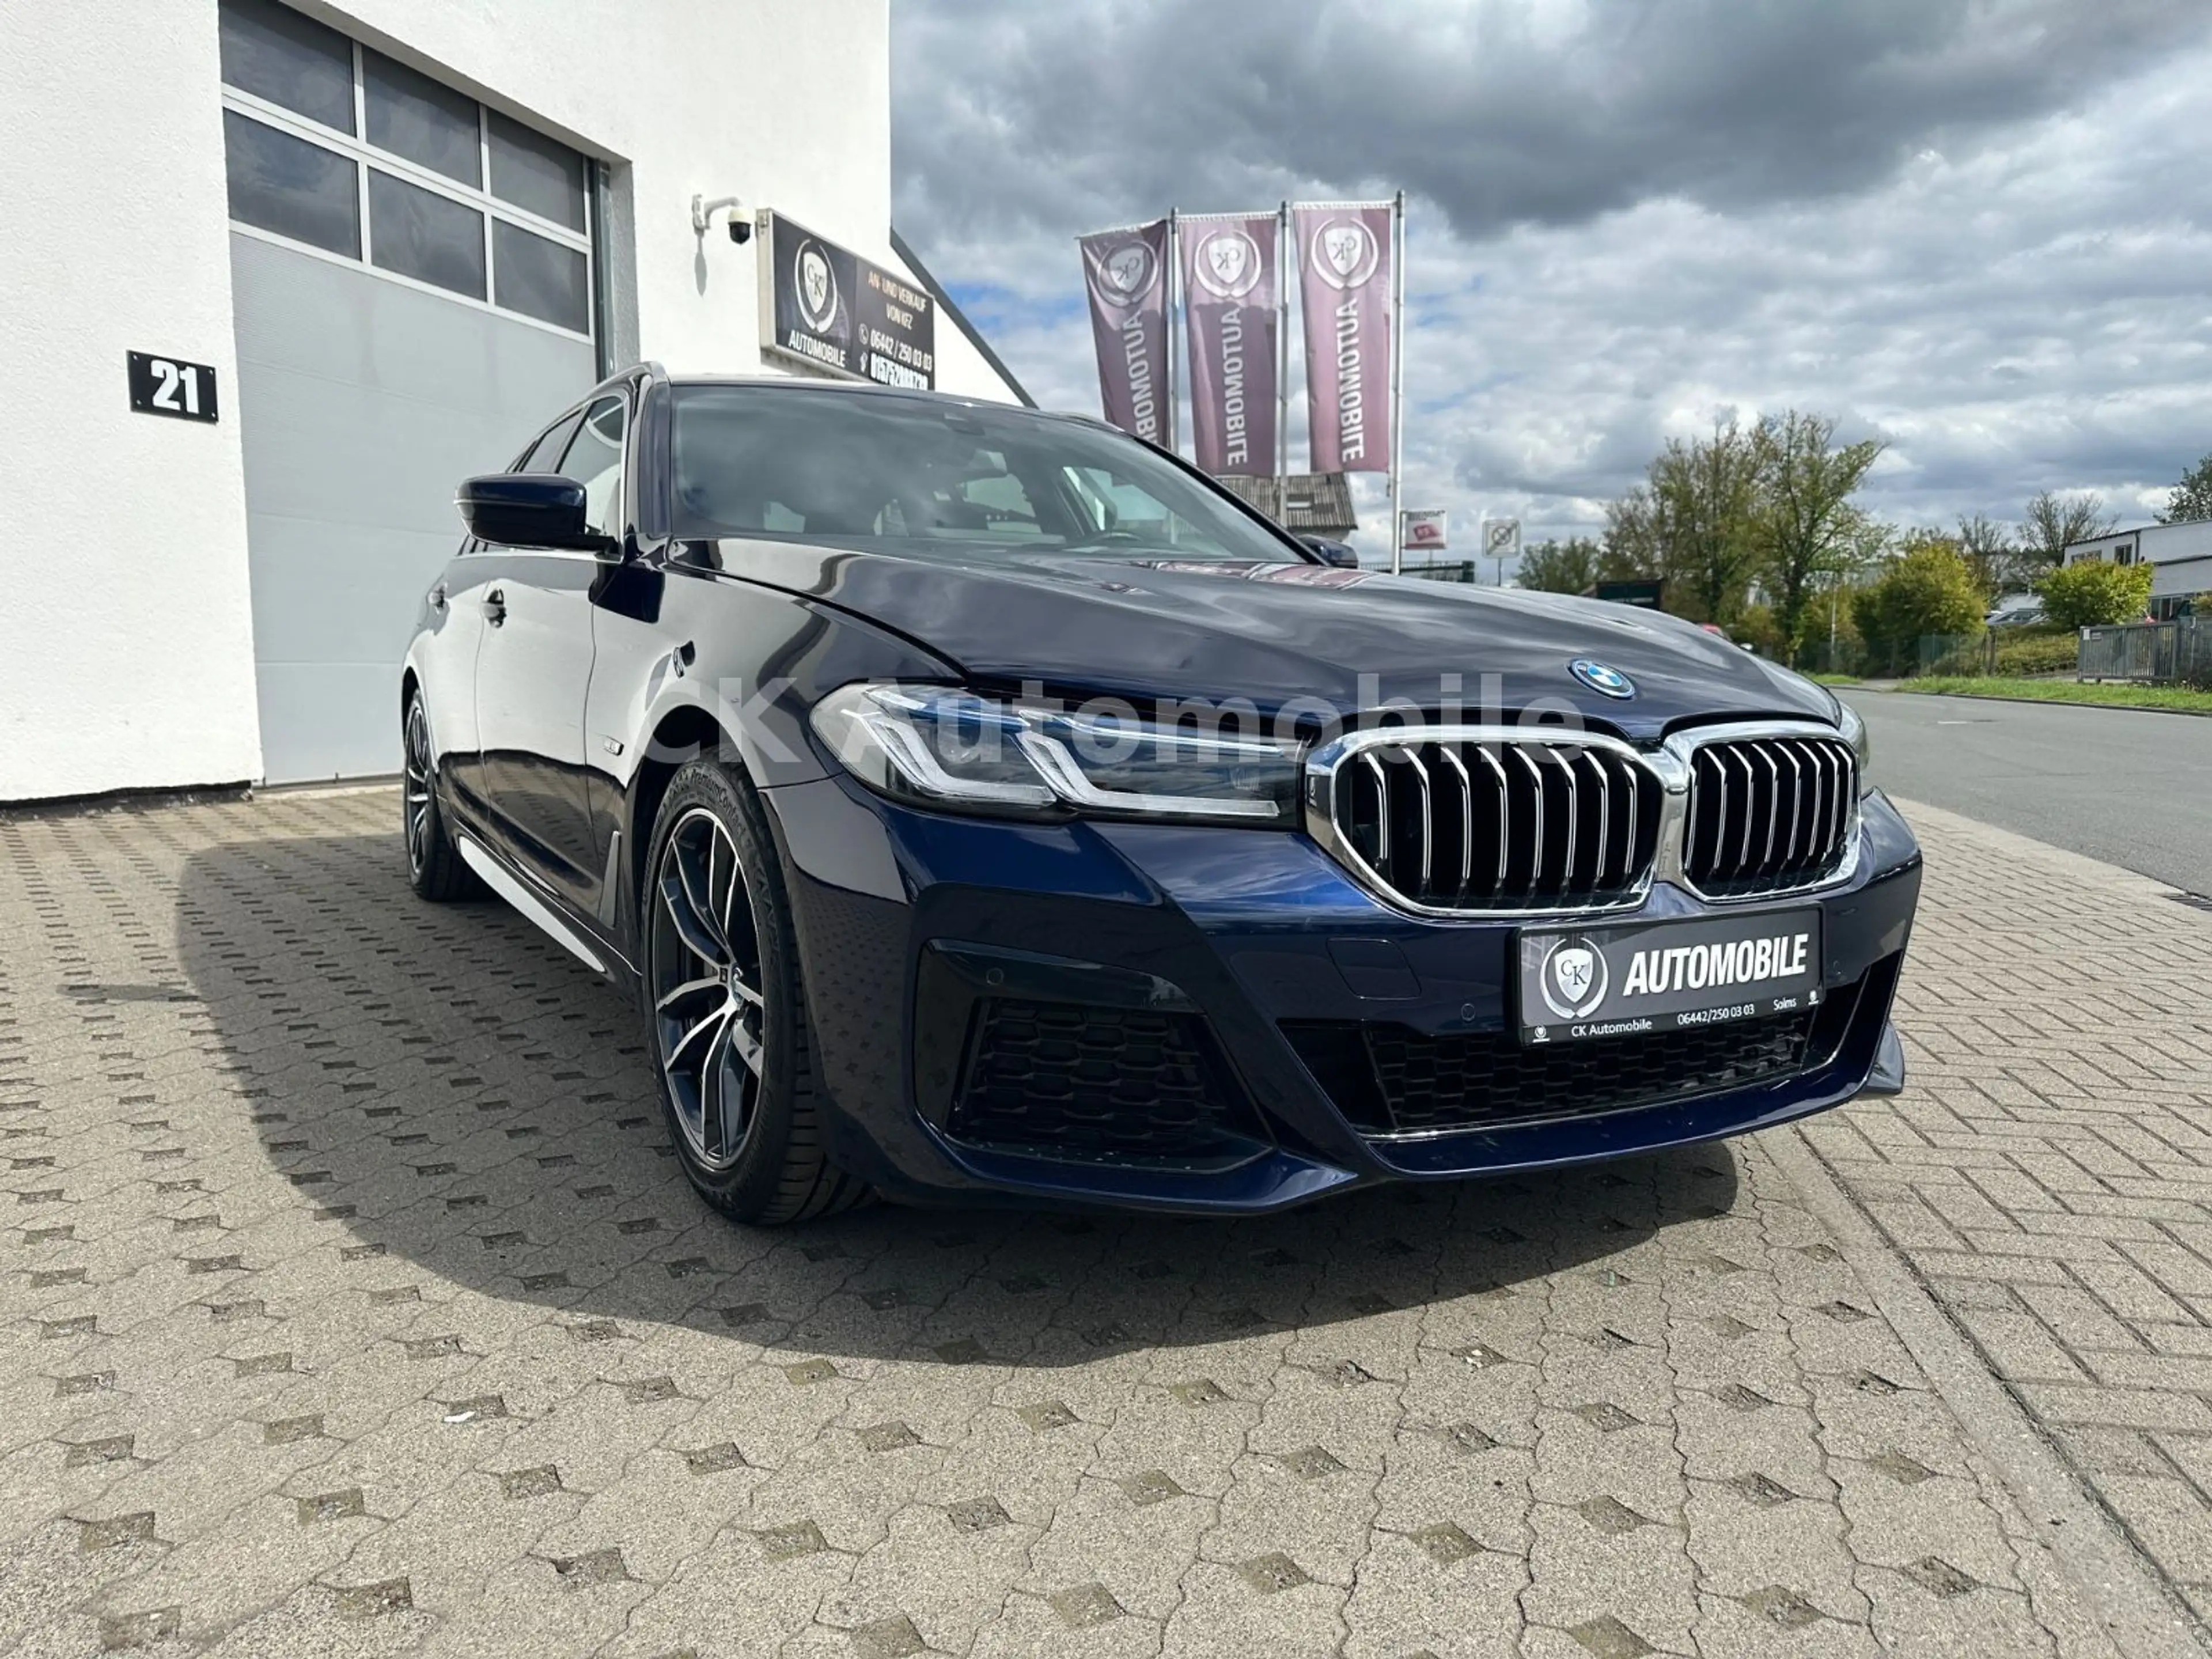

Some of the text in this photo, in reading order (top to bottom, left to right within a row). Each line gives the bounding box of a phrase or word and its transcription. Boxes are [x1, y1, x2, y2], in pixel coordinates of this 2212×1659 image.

[787, 329, 847, 368] AUTOMOBILE
[870, 328, 894, 355] 06442
[899, 341, 912, 364] 250
[912, 348, 922, 368] 03
[923, 352, 933, 373] 03
[150, 359, 199, 414] 21
[1560, 959, 1586, 986] CK
[1623, 934, 1809, 997] AUTOMOBILE
[1571, 996, 1797, 1037] CK Automobile 06442/250 03 03 Solms
